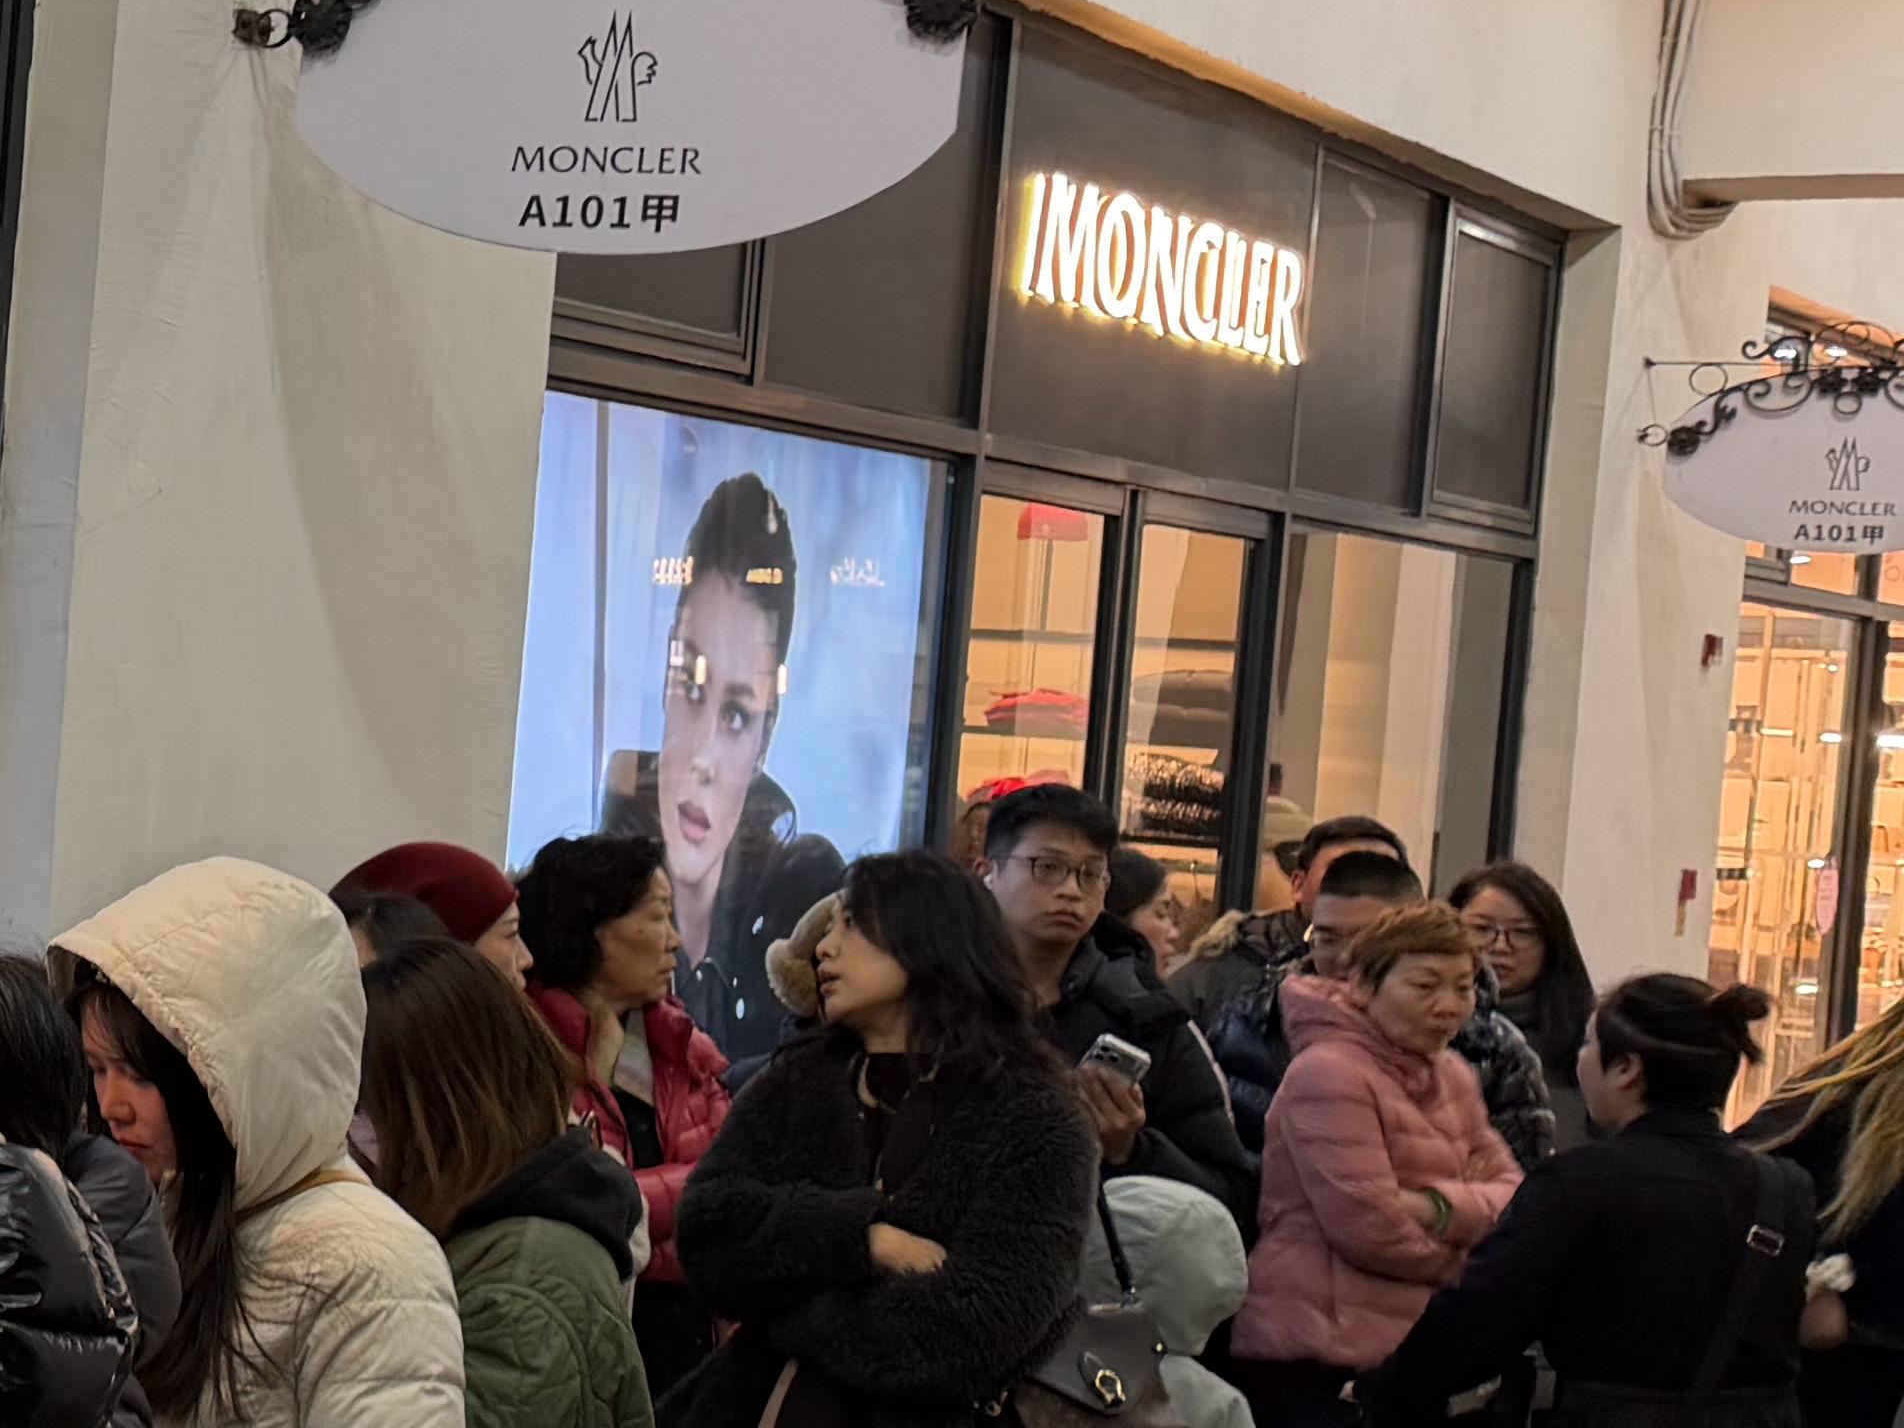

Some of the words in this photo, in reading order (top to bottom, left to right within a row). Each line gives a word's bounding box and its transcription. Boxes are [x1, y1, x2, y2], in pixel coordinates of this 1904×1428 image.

[511, 145, 702, 175] MONCLER
[518, 194, 680, 233] A101甲
[1018, 172, 1304, 367] MONCLER
[1789, 499, 1897, 517] MONCLER
[1794, 523, 1884, 545] A101甲
